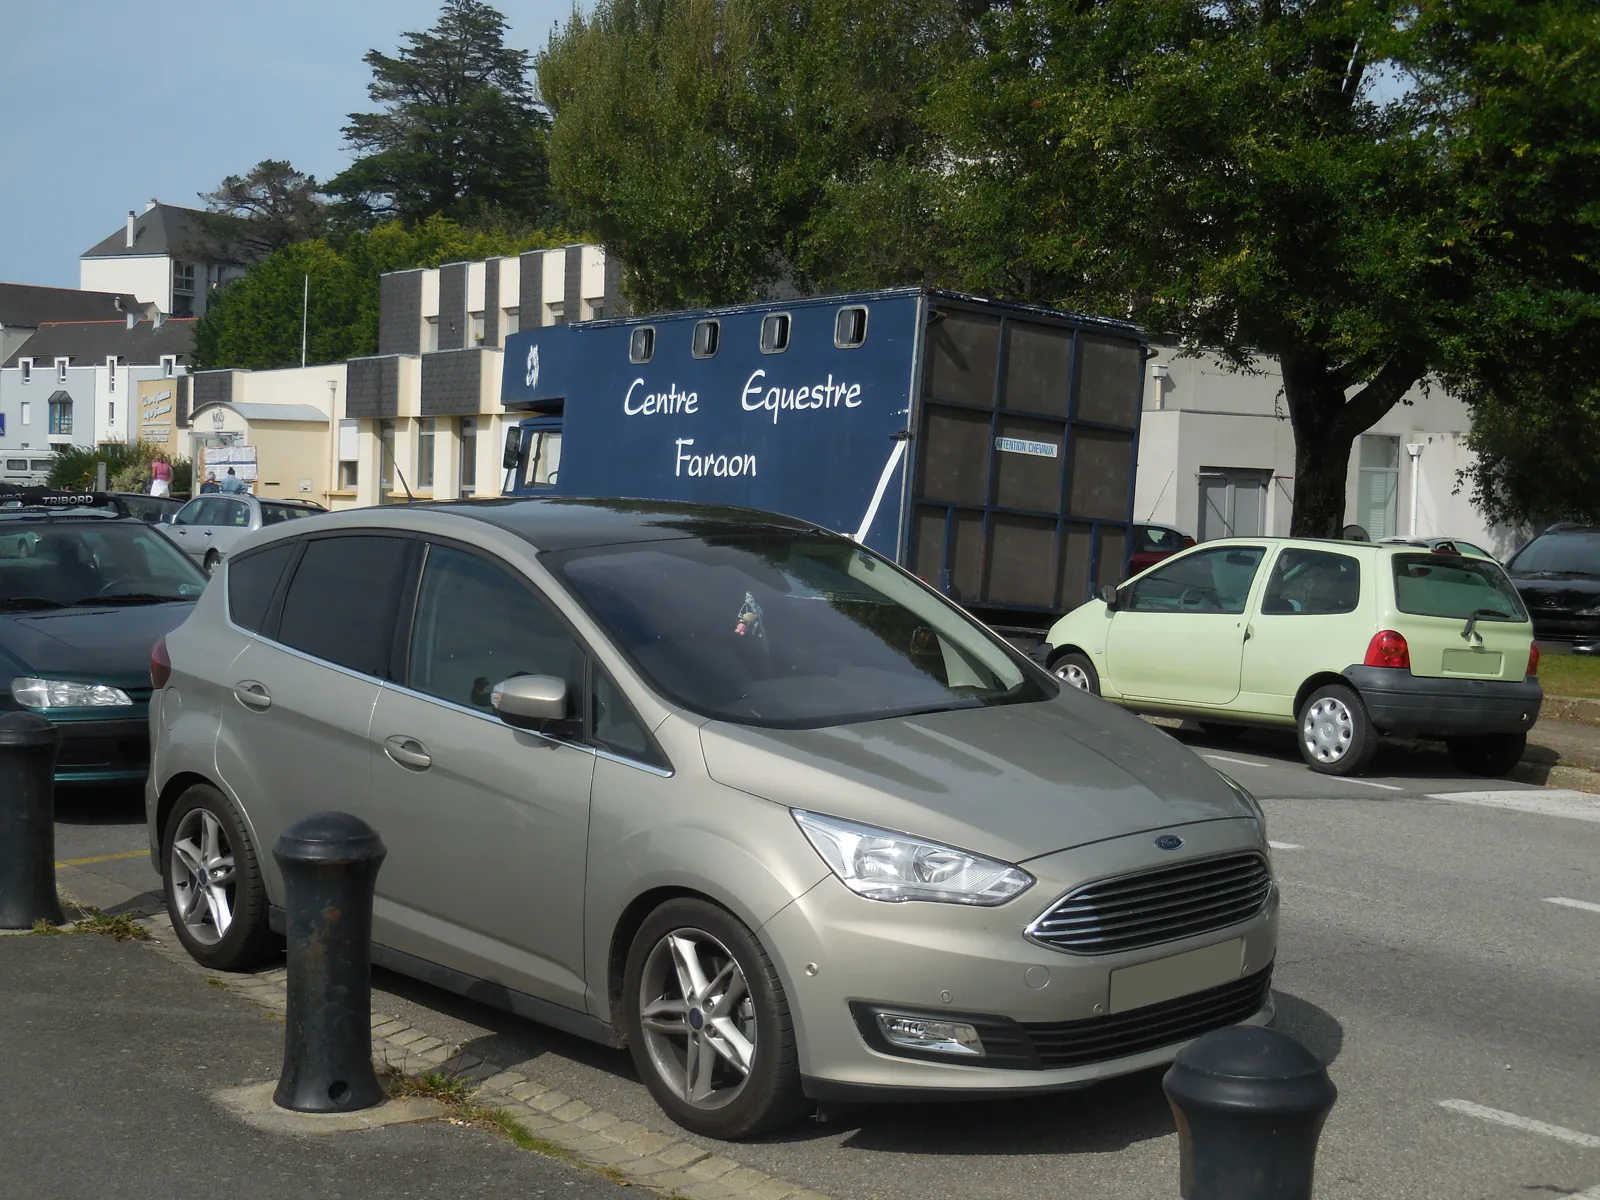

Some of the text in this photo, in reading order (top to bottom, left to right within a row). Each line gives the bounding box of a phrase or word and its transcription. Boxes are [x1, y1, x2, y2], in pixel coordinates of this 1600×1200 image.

[624, 369, 862, 424] Centre Equestre
[675, 438, 757, 477] Faraon
[996, 438, 1055, 456] ATTENTION CHEVAUX
[42, 495, 94, 505] TRIBORD
